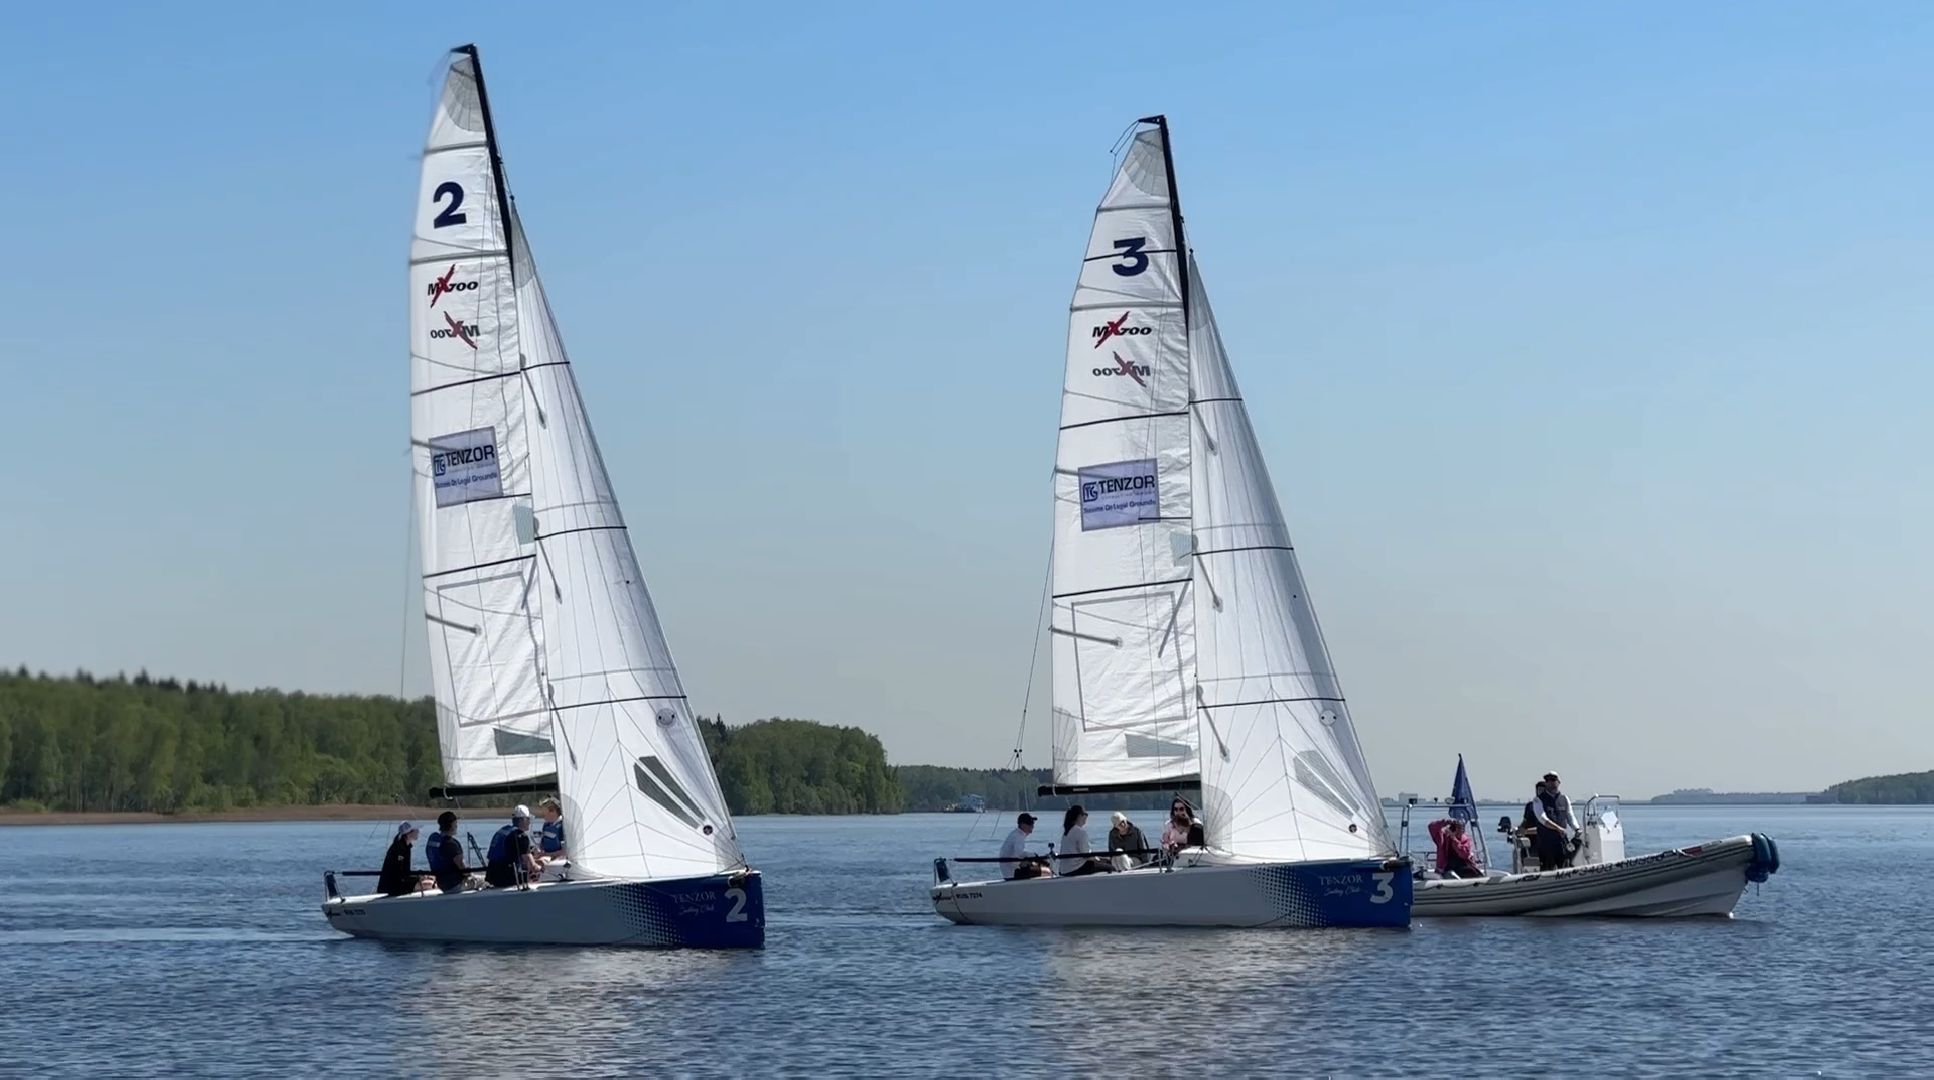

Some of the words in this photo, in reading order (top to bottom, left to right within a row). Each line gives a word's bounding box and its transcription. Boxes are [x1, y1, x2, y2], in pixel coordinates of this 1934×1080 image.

[432, 181, 467, 229] 2
[1112, 236, 1149, 277] 3
[427, 264, 479, 308] MX700
[1092, 311, 1152, 349] MX700
[445, 445, 495, 466] TENZOR
[1098, 475, 1155, 494] TENZOR
[724, 888, 748, 923] 2
[1370, 872, 1394, 904] 3
